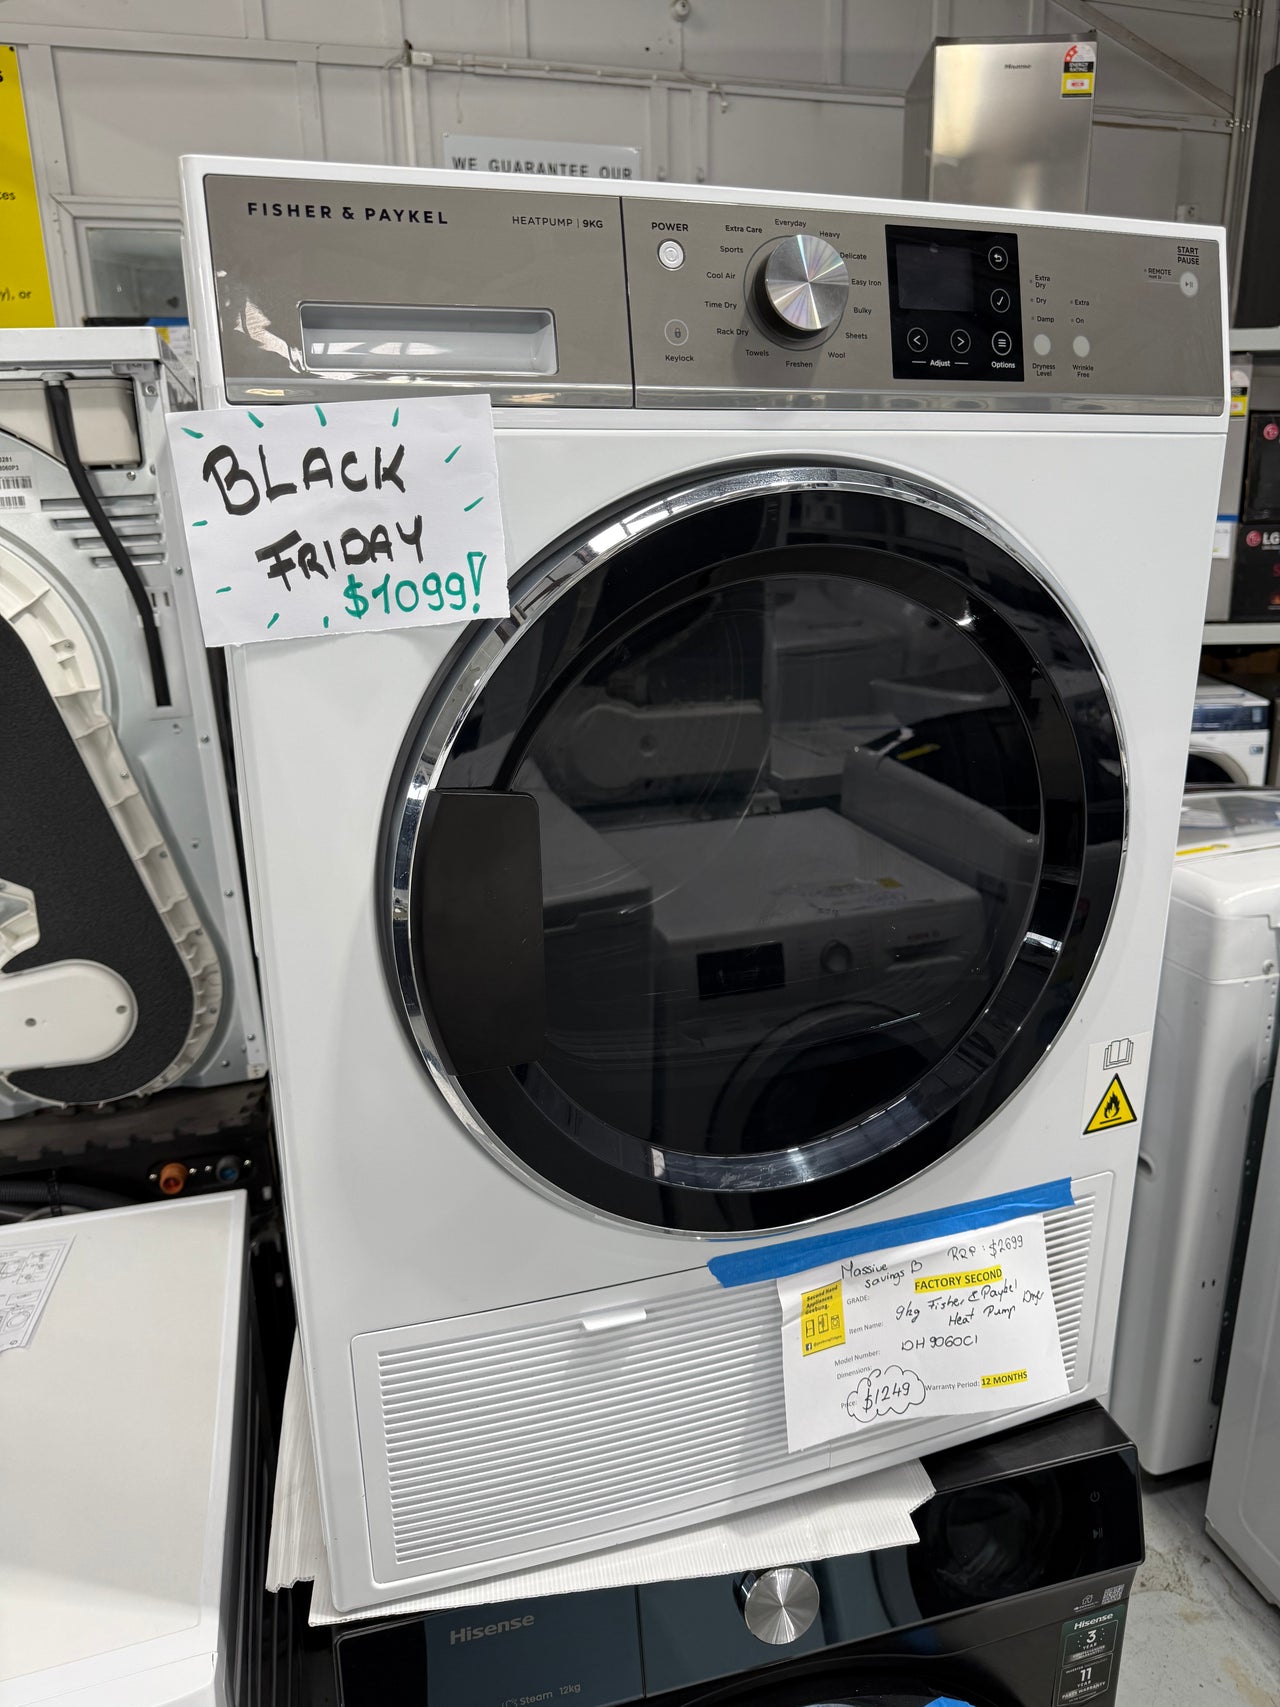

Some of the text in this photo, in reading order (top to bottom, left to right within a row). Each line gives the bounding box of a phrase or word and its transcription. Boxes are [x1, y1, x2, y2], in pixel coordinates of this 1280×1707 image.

[452, 157, 632, 180] WE GUARANTEE OUR
[248, 202, 448, 225] FISHER & PAYKEL
[512, 216, 604, 229] HEATPUMP 9KG
[651, 222, 689, 232] POWER
[774, 218, 807, 228] Everyday
[725, 224, 763, 234] Extra Care
[819, 230, 841, 239] Heavy
[719, 245, 744, 254] Sports
[1177, 245, 1199, 255] START
[839, 252, 868, 261] Delicate
[1177, 256, 1200, 266] PAUSE
[706, 271, 736, 280] Cool Air
[1148, 267, 1172, 276] REMOTE
[851, 279, 882, 288] Easy Iron
[1035, 274, 1051, 283] Extra
[1035, 281, 1046, 290] Dry
[704, 301, 737, 311] Time Dry
[1036, 297, 1047, 305] Dry
[1074, 298, 1090, 307] Extra
[853, 307, 872, 316] Bulky
[1036, 315, 1055, 324] Damp
[716, 328, 749, 338] Rack Dry
[845, 332, 868, 341] Sheets
[665, 354, 695, 363] Keylock
[745, 349, 770, 358] Towels
[828, 351, 846, 360] Wool
[785, 360, 813, 369] Freshen
[930, 359, 951, 369] Adjust
[991, 361, 1016, 370] Options
[1032, 362, 1056, 371] Dryness
[1072, 364, 1094, 373] Wrinkle
[1036, 369, 1052, 377] Level
[1077, 371, 1090, 379] Free
[202, 444, 406, 515] BLACK
[1262, 531, 1280, 545] LG
[255, 515, 423, 591] FRIDAY
[343, 552, 487, 619] $1099!
[988, 1234, 1024, 1259] $2699
[841, 1260, 888, 1279] Massive
[864, 1269, 905, 1288] savings
[914, 1268, 1002, 1291] FACTORY SECOND
[806, 1290, 825, 1302] Second
[846, 1294, 870, 1305] GRADE:
[928, 1296, 964, 1311] Fisher
[949, 1308, 974, 1326] Heat
[983, 1304, 1016, 1319] Pump
[849, 1321, 884, 1335] Item Name:
[834, 1349, 881, 1367] Model Number:
[836, 1365, 873, 1380] Dimensions:
[925, 1370, 1028, 1392] Warranty Period: 12 MONTHS
[862, 1382, 911, 1414] $1249
[840, 1399, 857, 1409] Price:
[1073, 1613, 1114, 1630] Hisense
[450, 1614, 535, 1645] Hisense
[1086, 1629, 1097, 1643] 3
[1083, 1642, 1097, 1650] YEAR
[1080, 1667, 1092, 1682] 11
[520, 1683, 582, 1706] Steam 12kg
